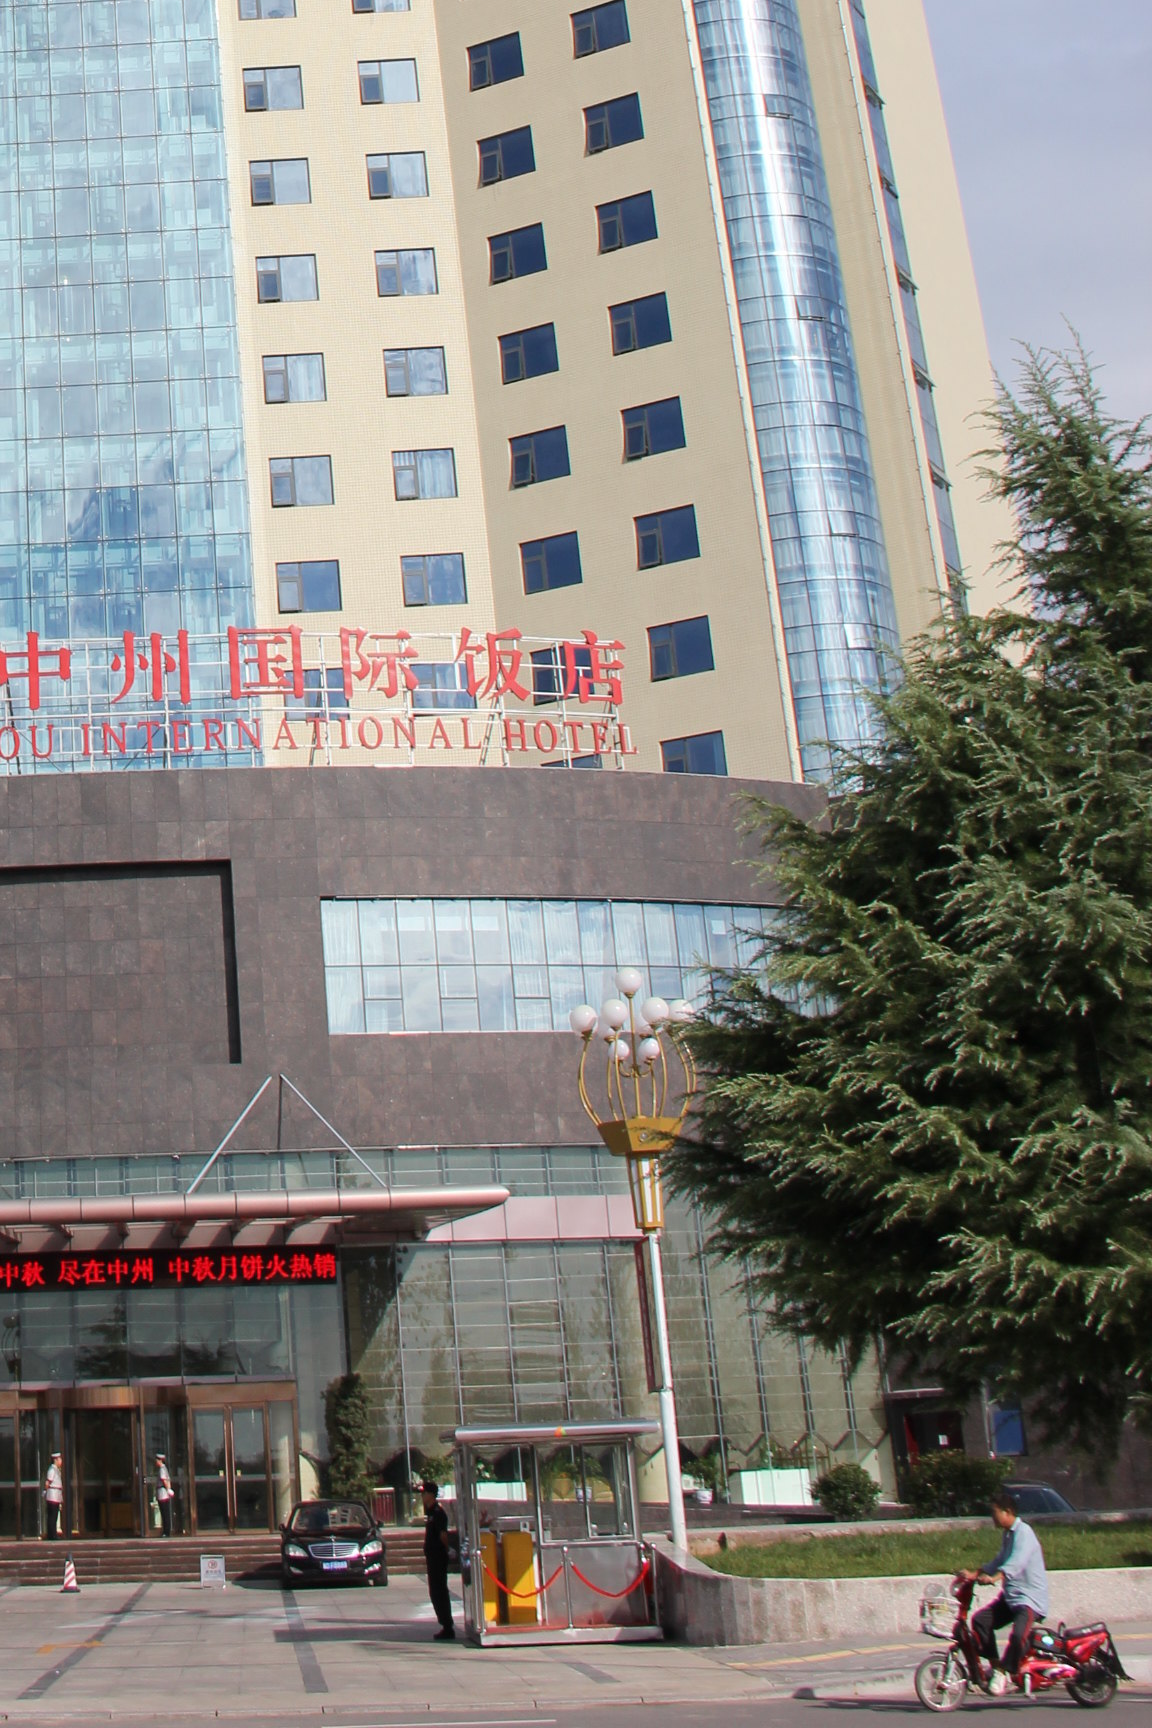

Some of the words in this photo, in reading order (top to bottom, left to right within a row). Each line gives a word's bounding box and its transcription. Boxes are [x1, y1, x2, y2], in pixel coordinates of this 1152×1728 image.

[82, 716, 484, 757] INTERNATIONAL
[504, 718, 639, 755] HOTEL
[57, 1257, 154, 1285] 尽在中州
[168, 1253, 336, 1282] 中秋月饼火热销
